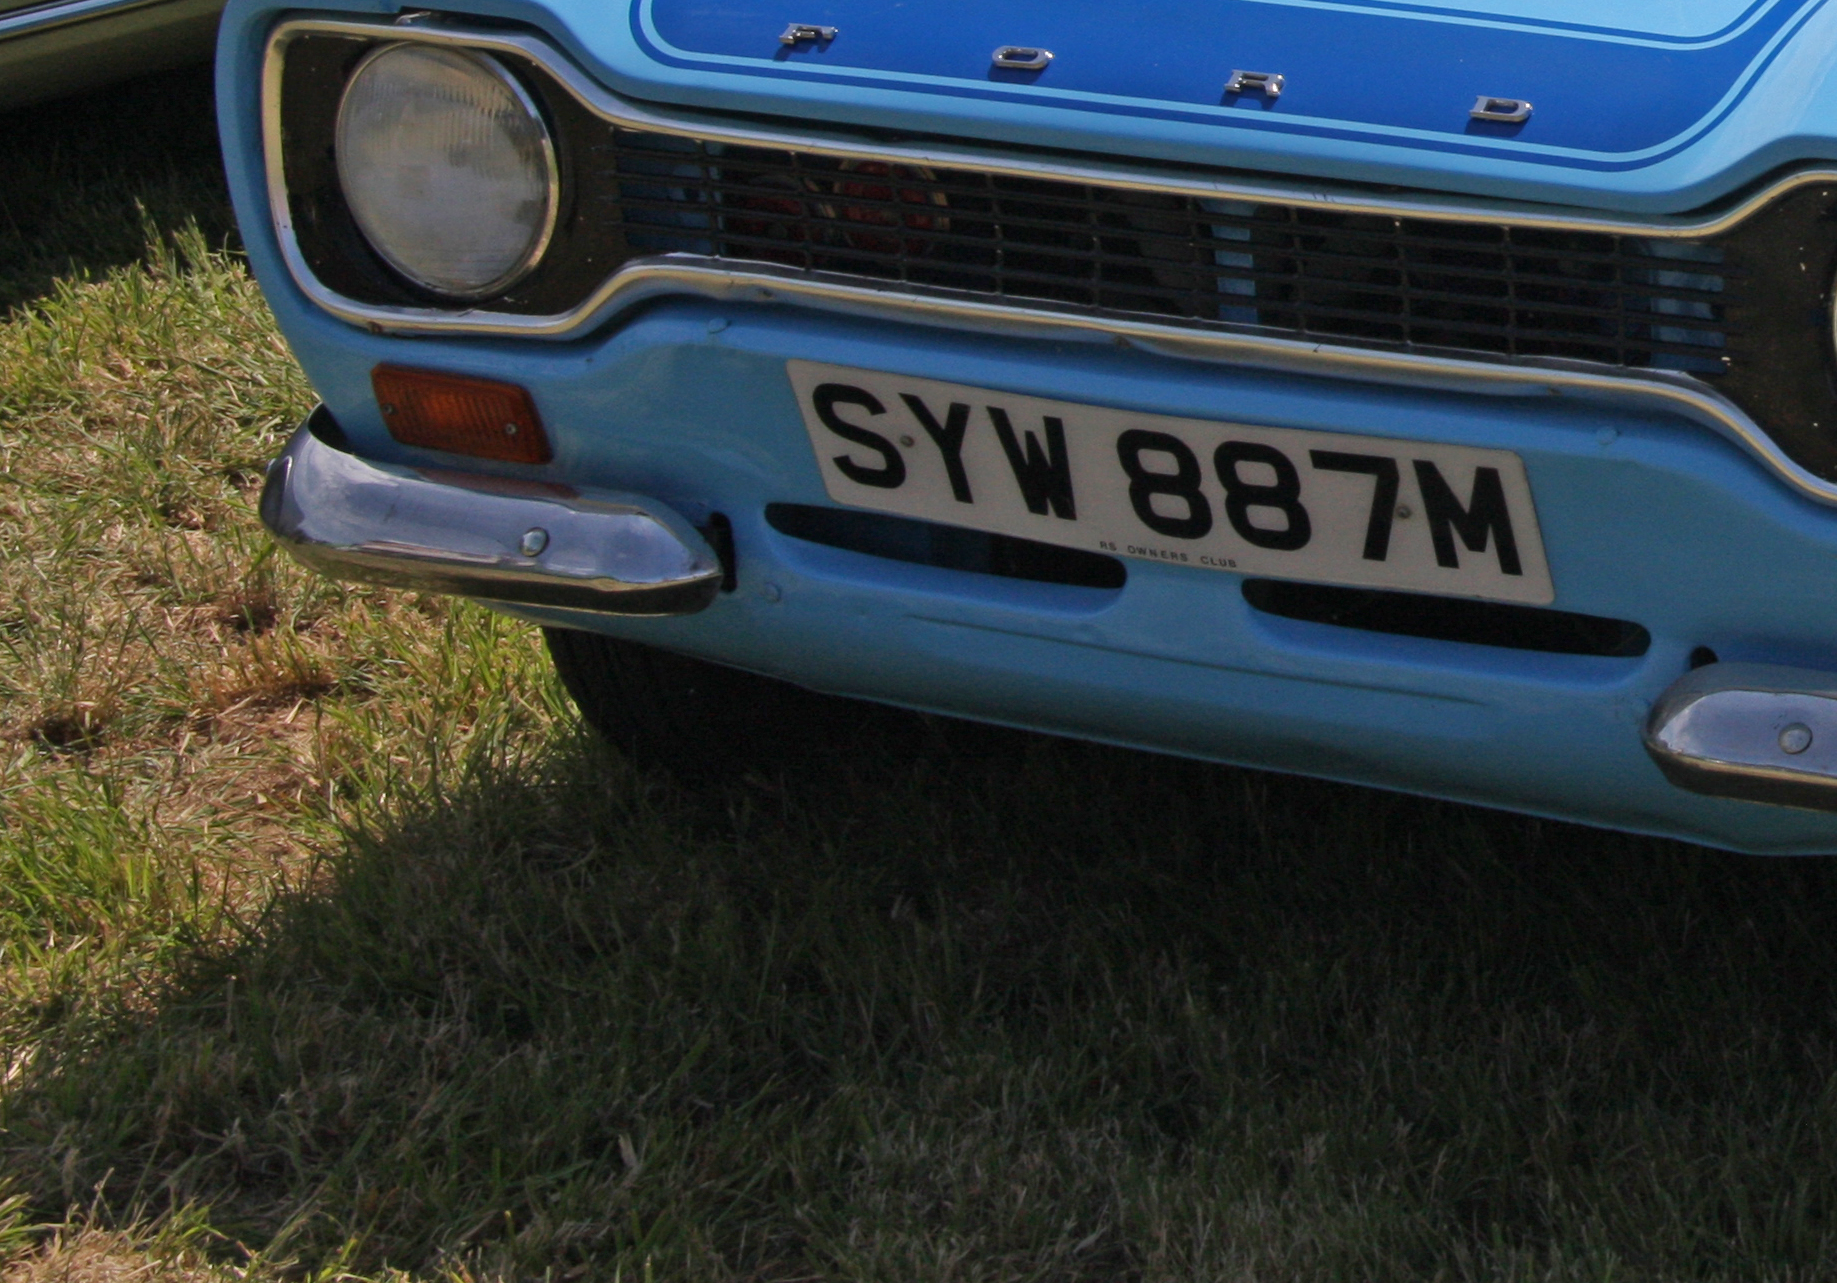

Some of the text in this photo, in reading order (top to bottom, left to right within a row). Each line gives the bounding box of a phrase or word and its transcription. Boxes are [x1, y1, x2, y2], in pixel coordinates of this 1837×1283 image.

[778, 21, 1534, 124] FORD
[812, 382, 1524, 577] SYW 887M
[1099, 540, 1237, 568] RS OWNERS CLUB
